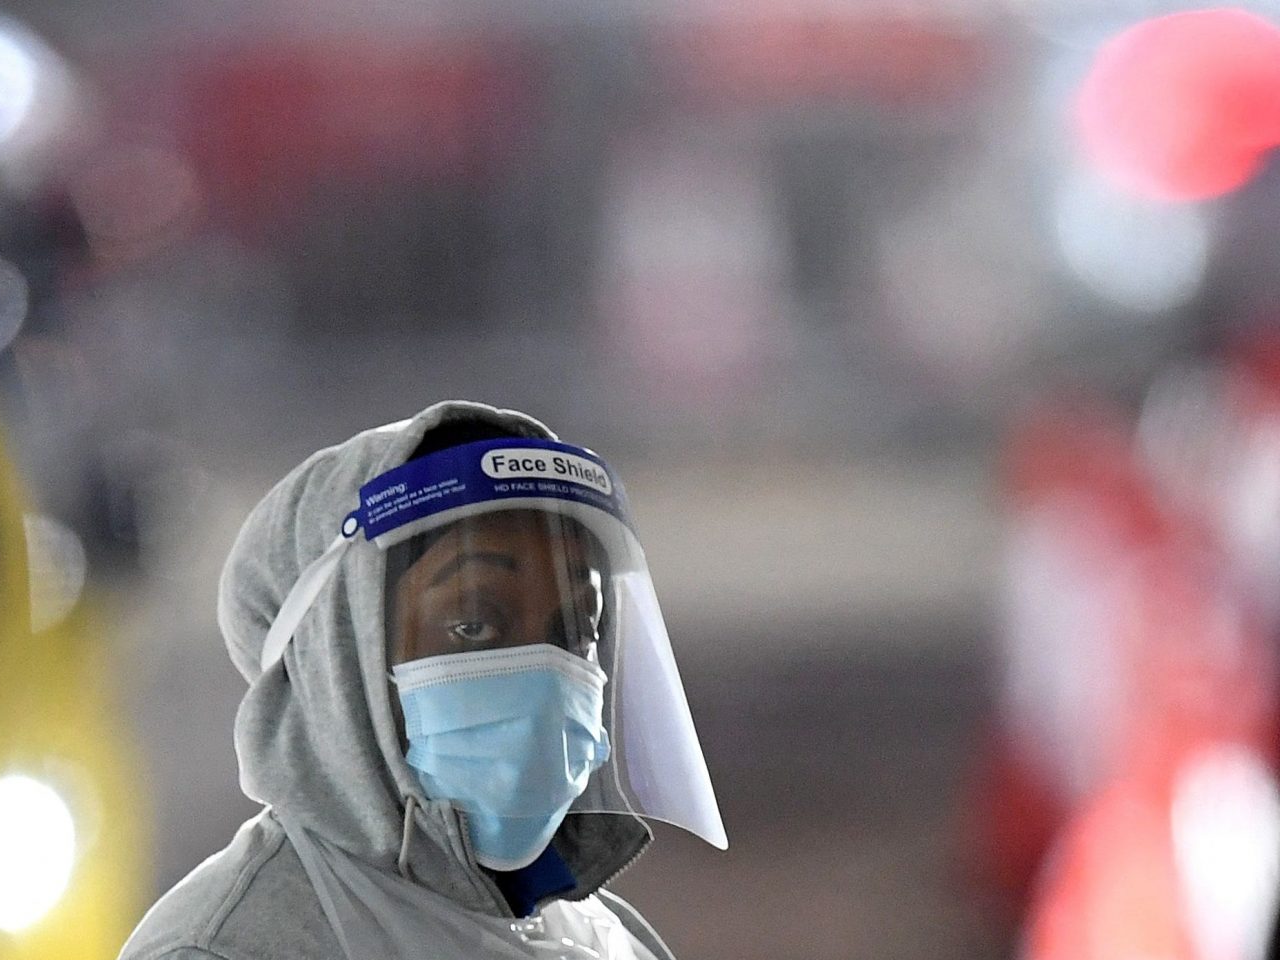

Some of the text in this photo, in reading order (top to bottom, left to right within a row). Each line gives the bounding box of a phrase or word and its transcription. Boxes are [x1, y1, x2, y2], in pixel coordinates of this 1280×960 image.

[491, 455, 608, 488] Face Shield
[365, 482, 408, 507] Warning:
[510, 482, 536, 491] FACE
